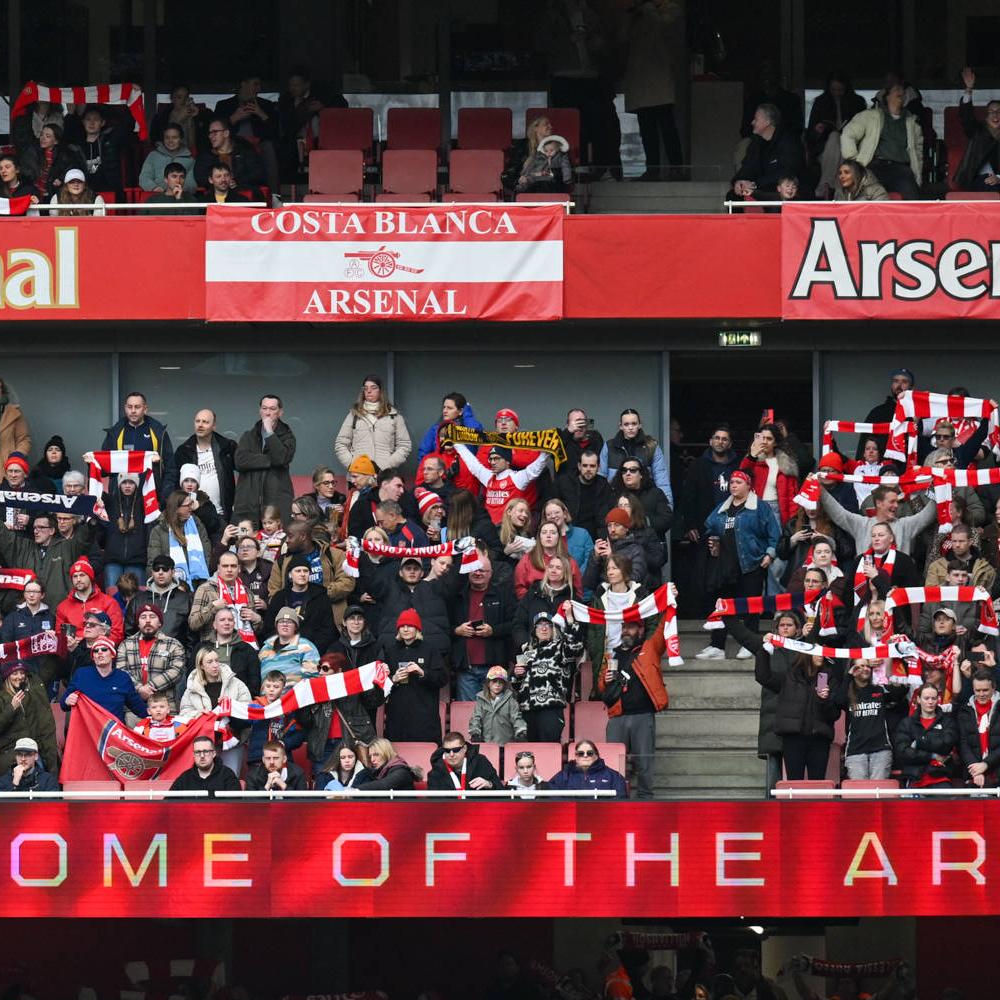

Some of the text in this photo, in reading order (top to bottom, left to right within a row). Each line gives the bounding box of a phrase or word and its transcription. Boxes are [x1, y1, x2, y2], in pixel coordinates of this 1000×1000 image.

[250, 209, 518, 235] COSTA BLANCA
[788, 216, 1000, 301] Arse
[303, 288, 468, 315] ARSENAL
[332, 832, 470, 887] OF
[547, 832, 765, 887] THE
[843, 831, 988, 886] AR
